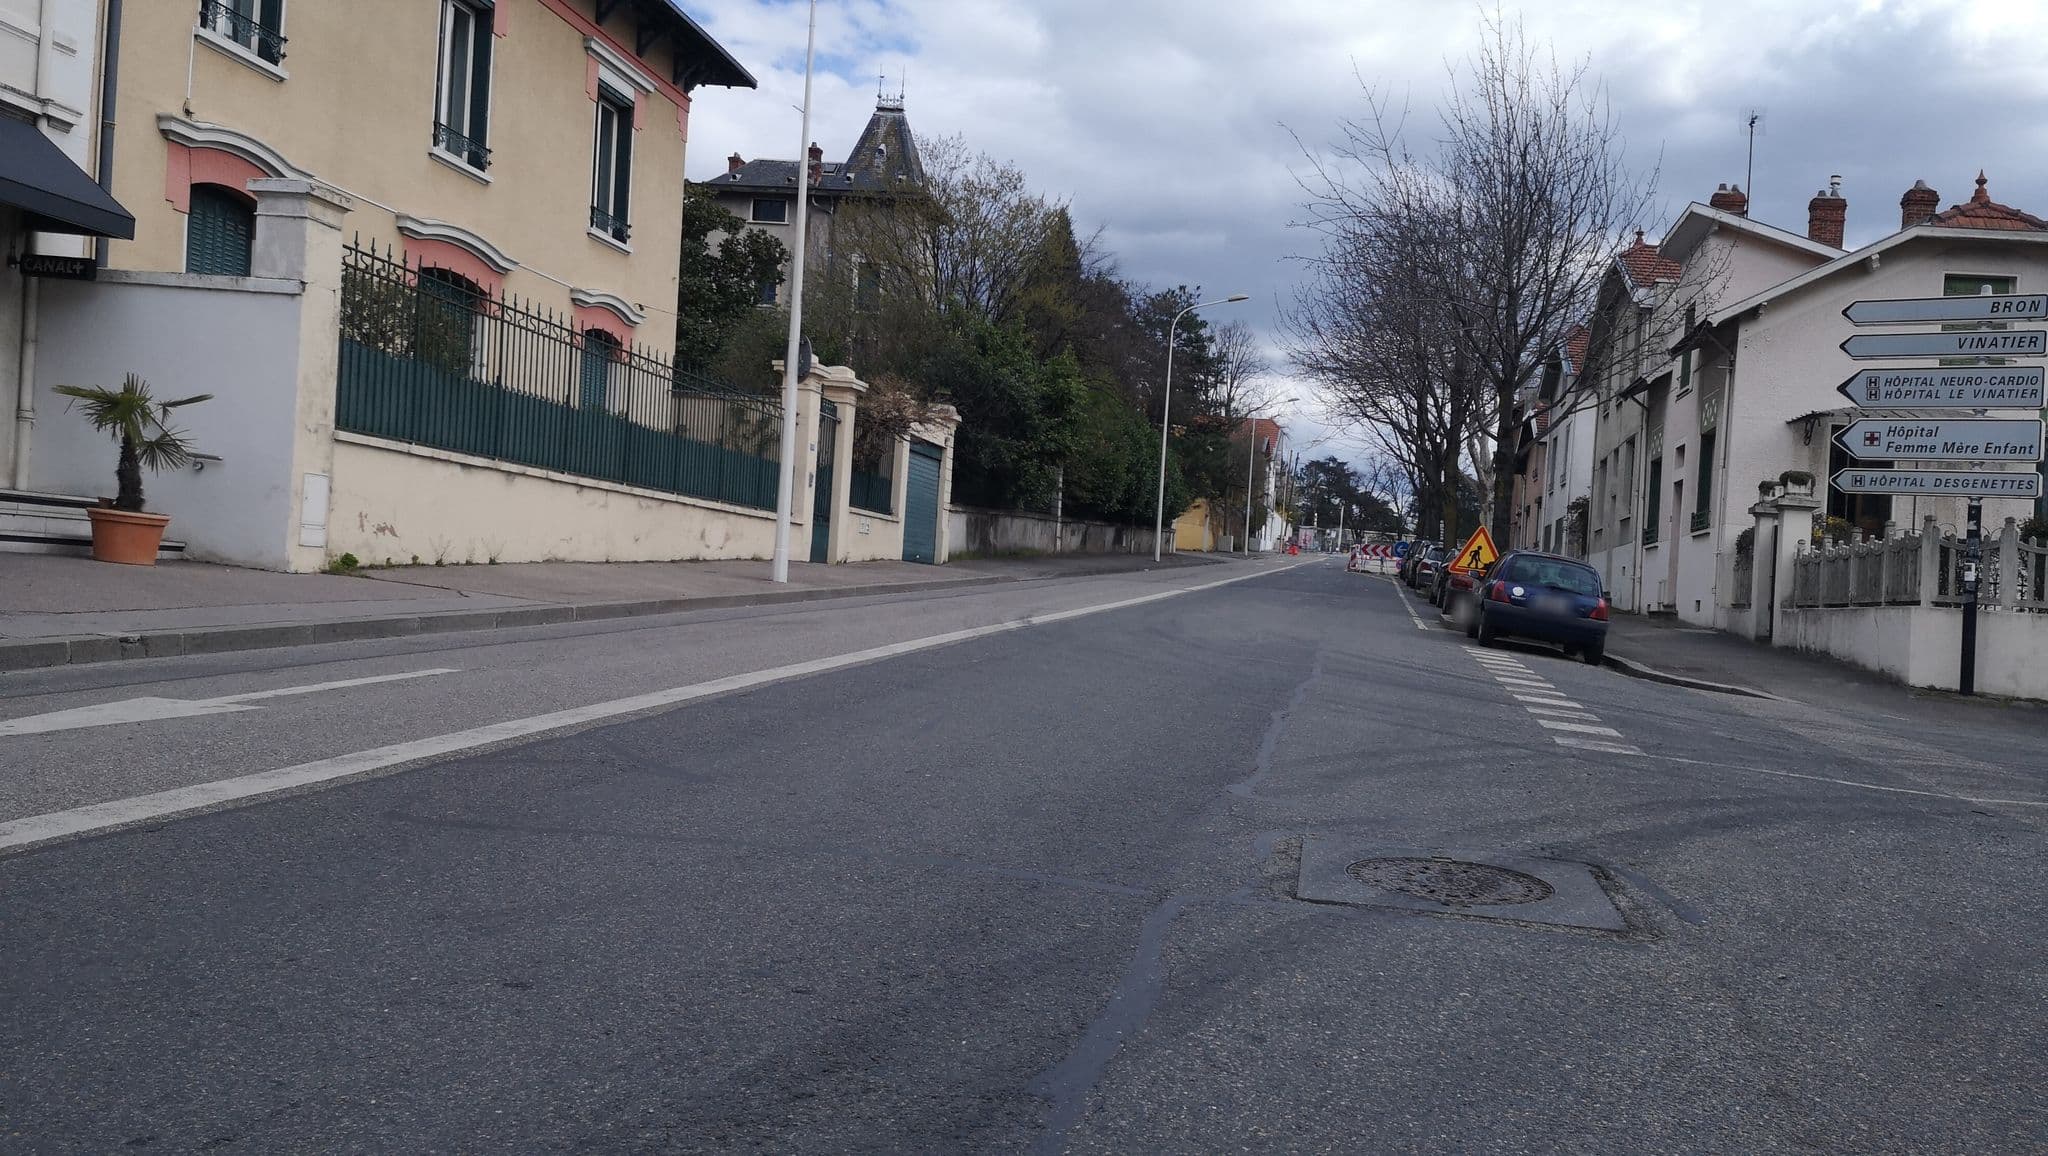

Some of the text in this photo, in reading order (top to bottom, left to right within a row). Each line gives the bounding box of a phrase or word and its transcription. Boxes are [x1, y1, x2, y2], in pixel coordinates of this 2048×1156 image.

[24, 258, 84, 274] CANAL+
[1990, 301, 2041, 314] BRON
[1958, 336, 2039, 349] VINATIER
[1884, 375, 1935, 387] HÔPITAL
[1940, 375, 2039, 387] NEURO-CARDIO
[1884, 388, 1941, 400] HÔPITAL
[1949, 390, 1965, 399] LE
[1973, 389, 2038, 399] VINATIER
[1886, 426, 1940, 441] Hôpital
[1885, 442, 2034, 455] Femme Mère Enfant
[1869, 475, 1926, 487] HÔPITAL
[1934, 478, 2035, 490] DESGENETTES
